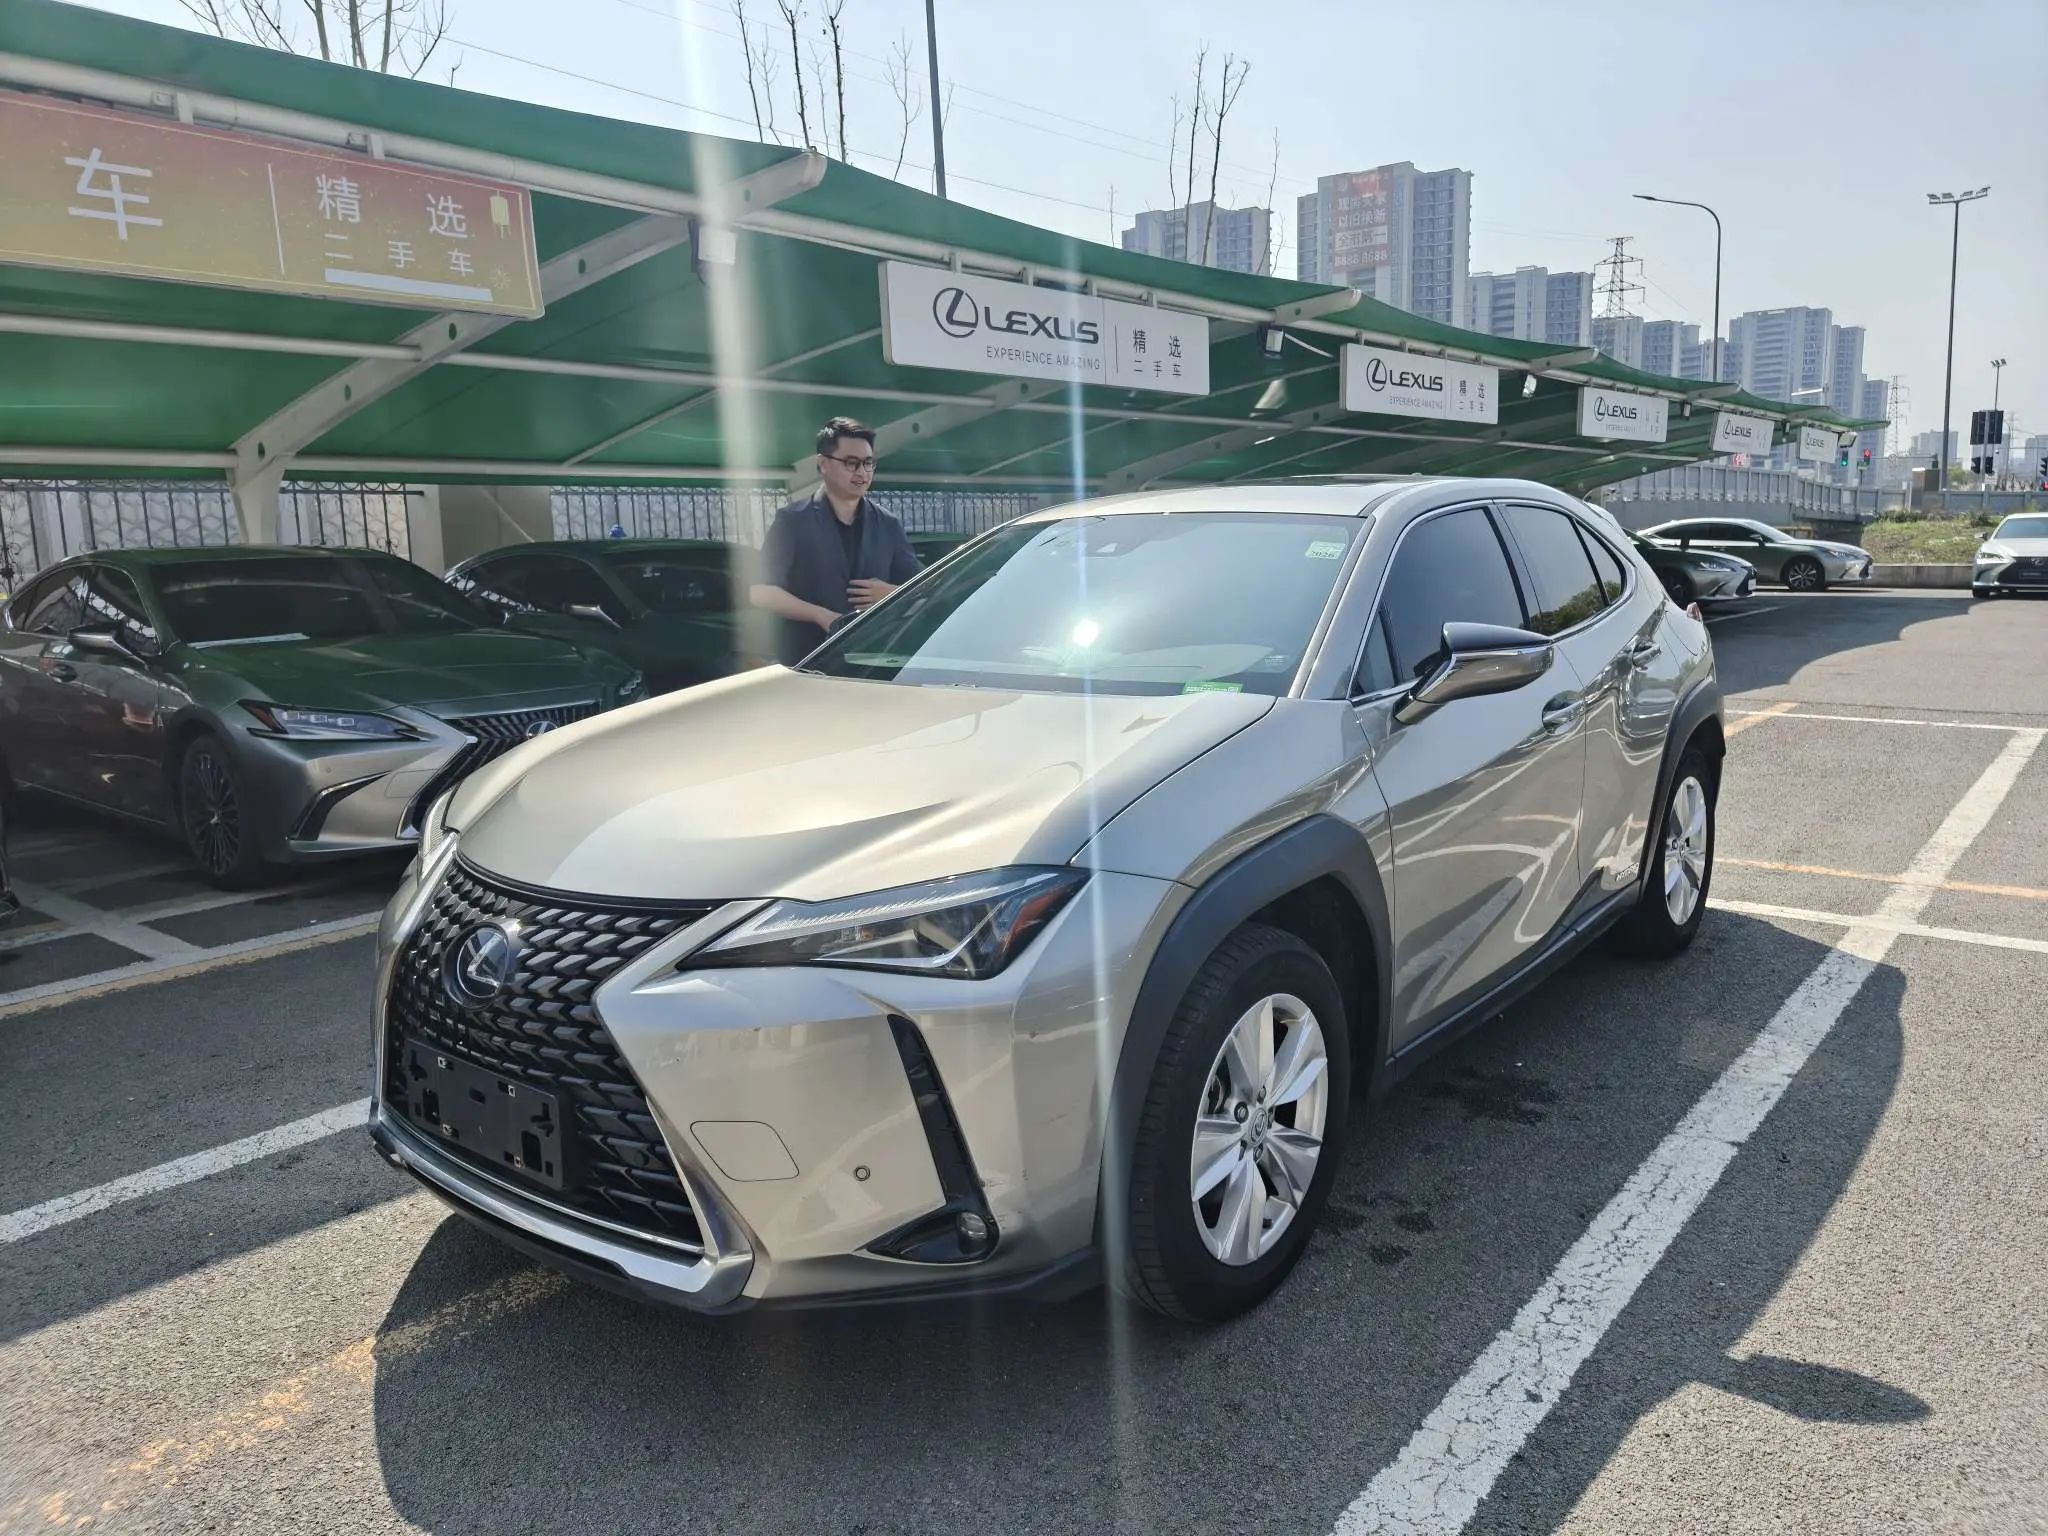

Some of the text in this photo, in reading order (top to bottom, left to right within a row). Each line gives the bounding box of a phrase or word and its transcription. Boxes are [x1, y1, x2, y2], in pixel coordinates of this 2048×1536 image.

[64, 148, 163, 241] 车
[316, 174, 469, 239] 精选
[324, 232, 475, 277] 二手车
[984, 306, 1099, 345] LEXUS
[1133, 329, 1182, 358] 精选
[986, 345, 1101, 371] EXPERIENCE AMAZING
[1133, 359, 1182, 378] 二手车
[1390, 370, 1443, 392] LEXUS
[1607, 404, 1637, 419] LEXUS
[1731, 425, 1752, 438] LEXUS
